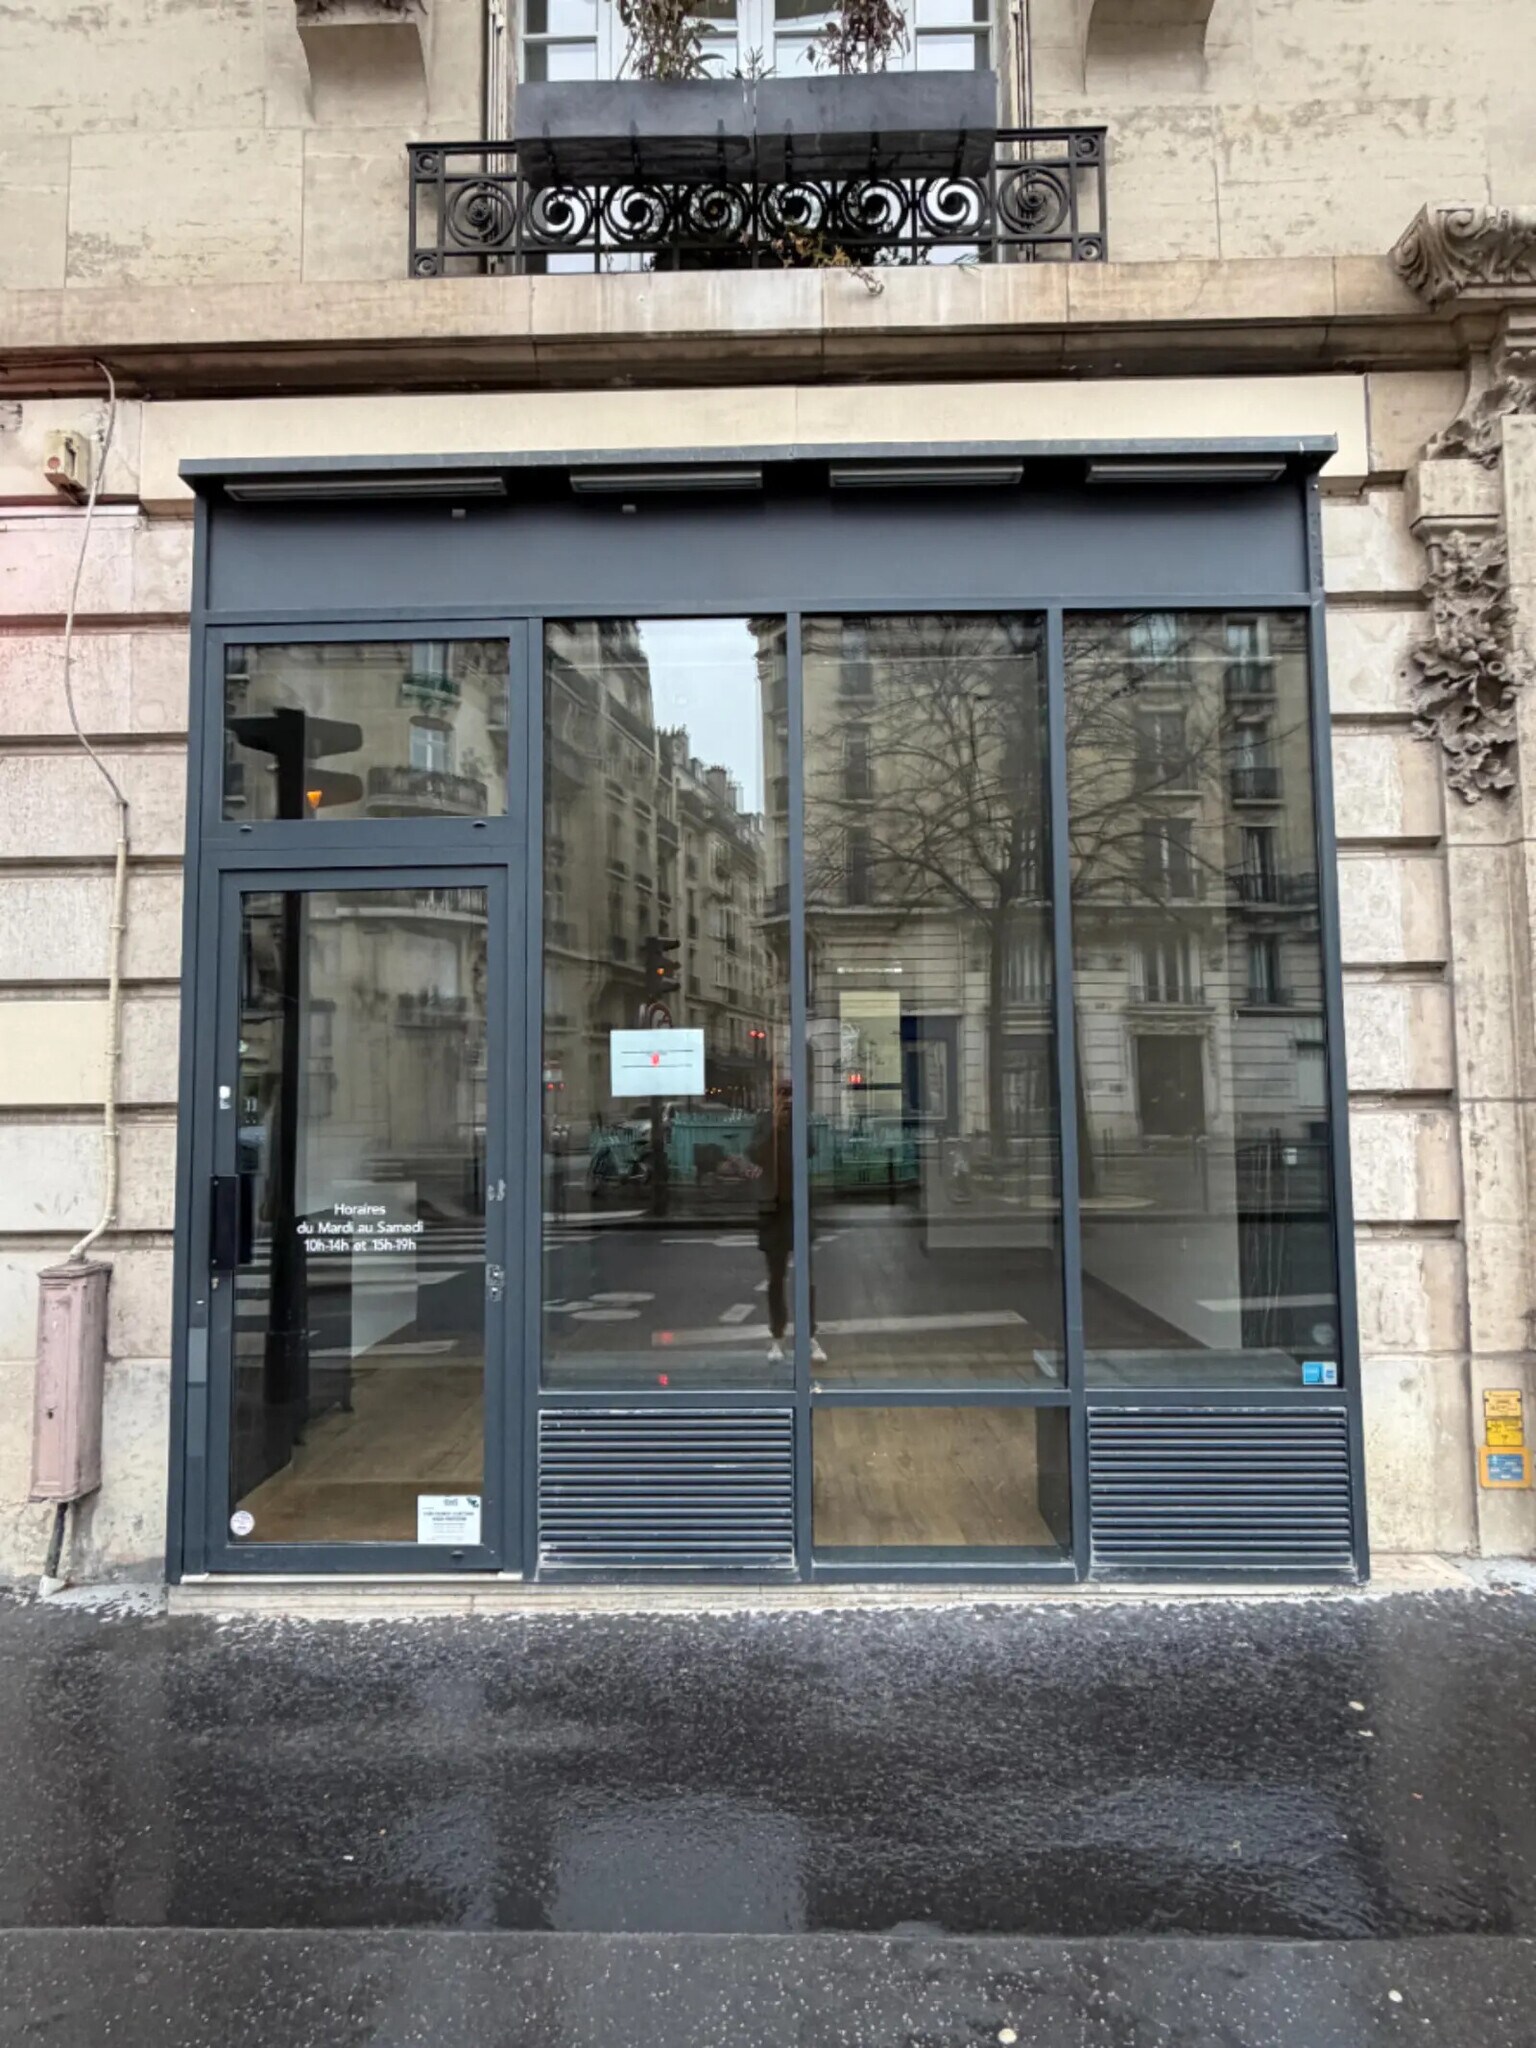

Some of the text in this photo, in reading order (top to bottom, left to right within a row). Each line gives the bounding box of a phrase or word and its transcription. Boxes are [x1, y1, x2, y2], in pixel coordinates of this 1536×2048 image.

[334, 1203, 386, 1215] Horaires
[297, 1220, 424, 1234] du Mardi au Samedi
[353, 1241, 367, 1251] et
